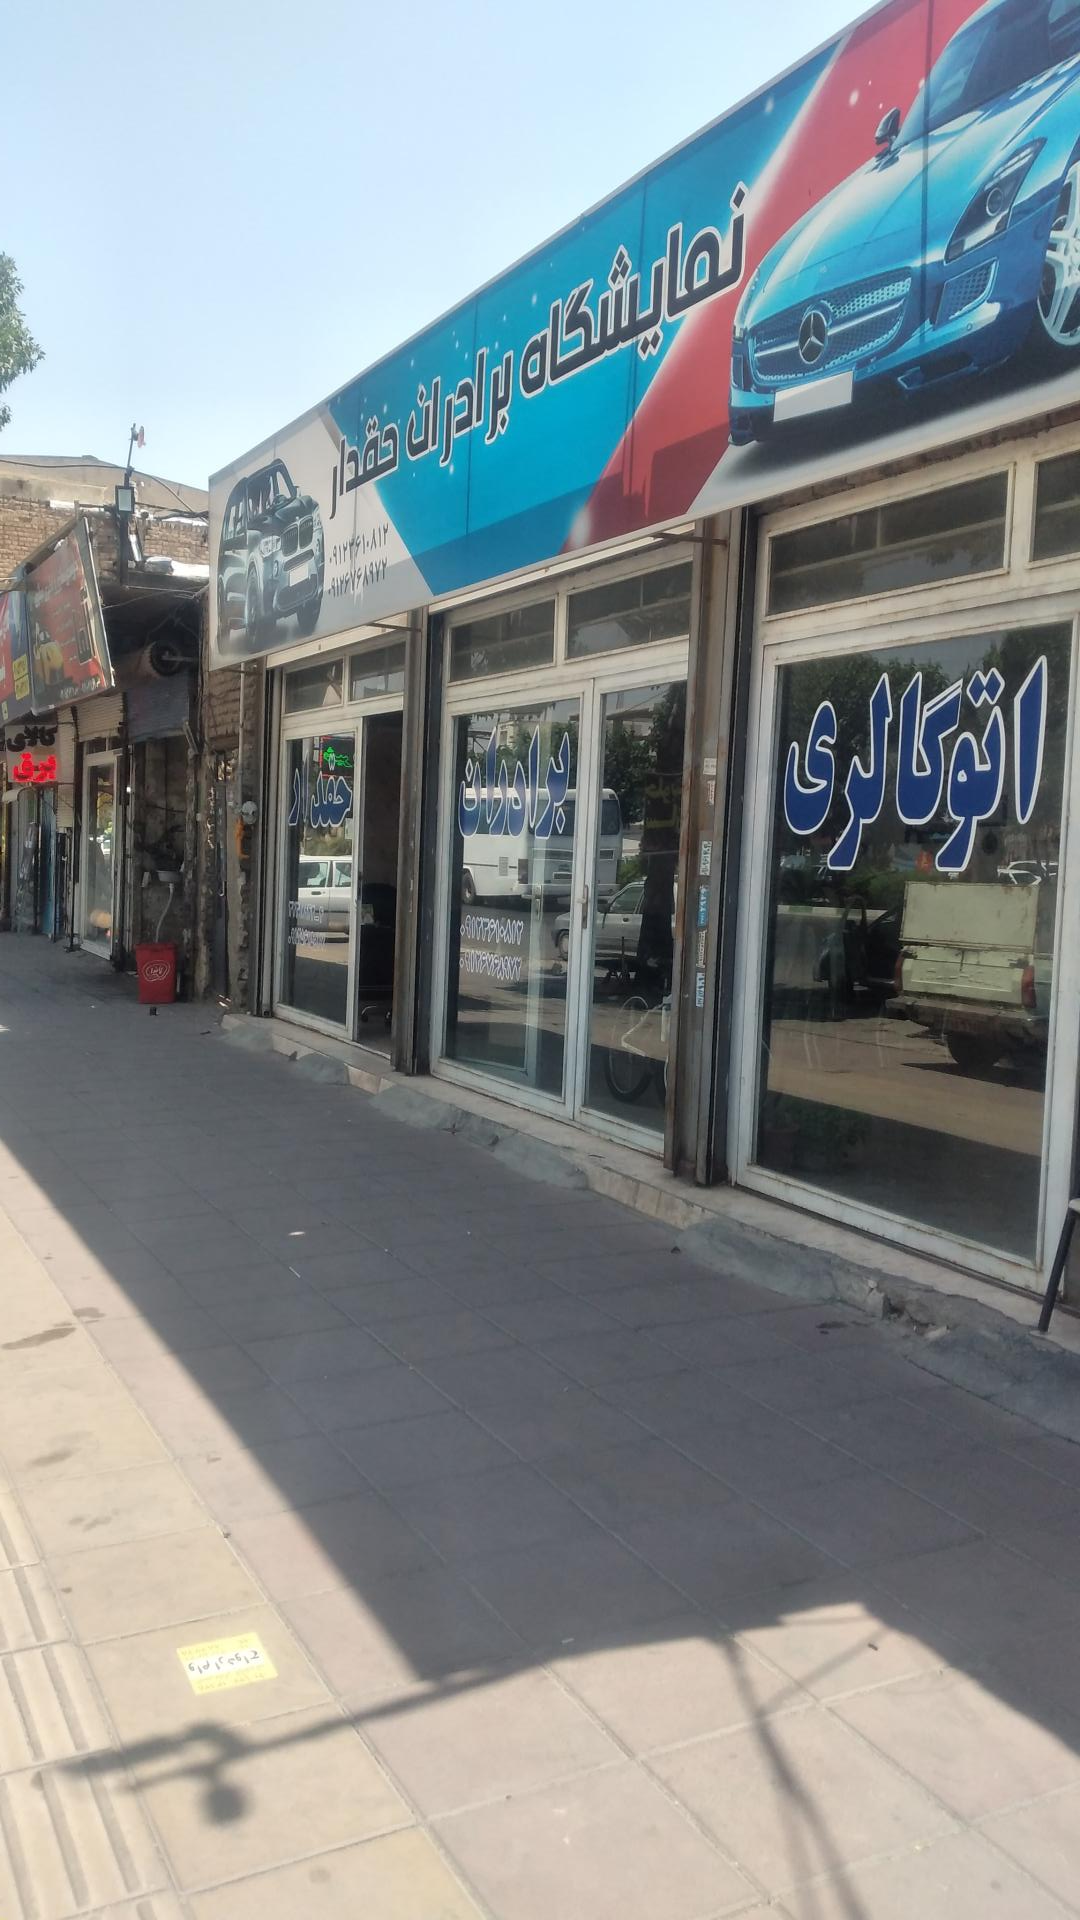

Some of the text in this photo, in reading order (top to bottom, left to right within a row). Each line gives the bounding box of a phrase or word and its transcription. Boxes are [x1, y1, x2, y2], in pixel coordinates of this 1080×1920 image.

[329, 181, 749, 520] نمایشگاه برادران حقدار
[328, 522, 389, 566] ۰۹۱۲۳۶۱۰۸۱۲
[328, 556, 388, 598] ۰۹۱۲۶۷۶۸۹۷۲
[7, 725, 58, 752] کالای
[13, 752, 57, 783] برق
[288, 750, 353, 828] حقدار
[457, 724, 571, 840] برادران
